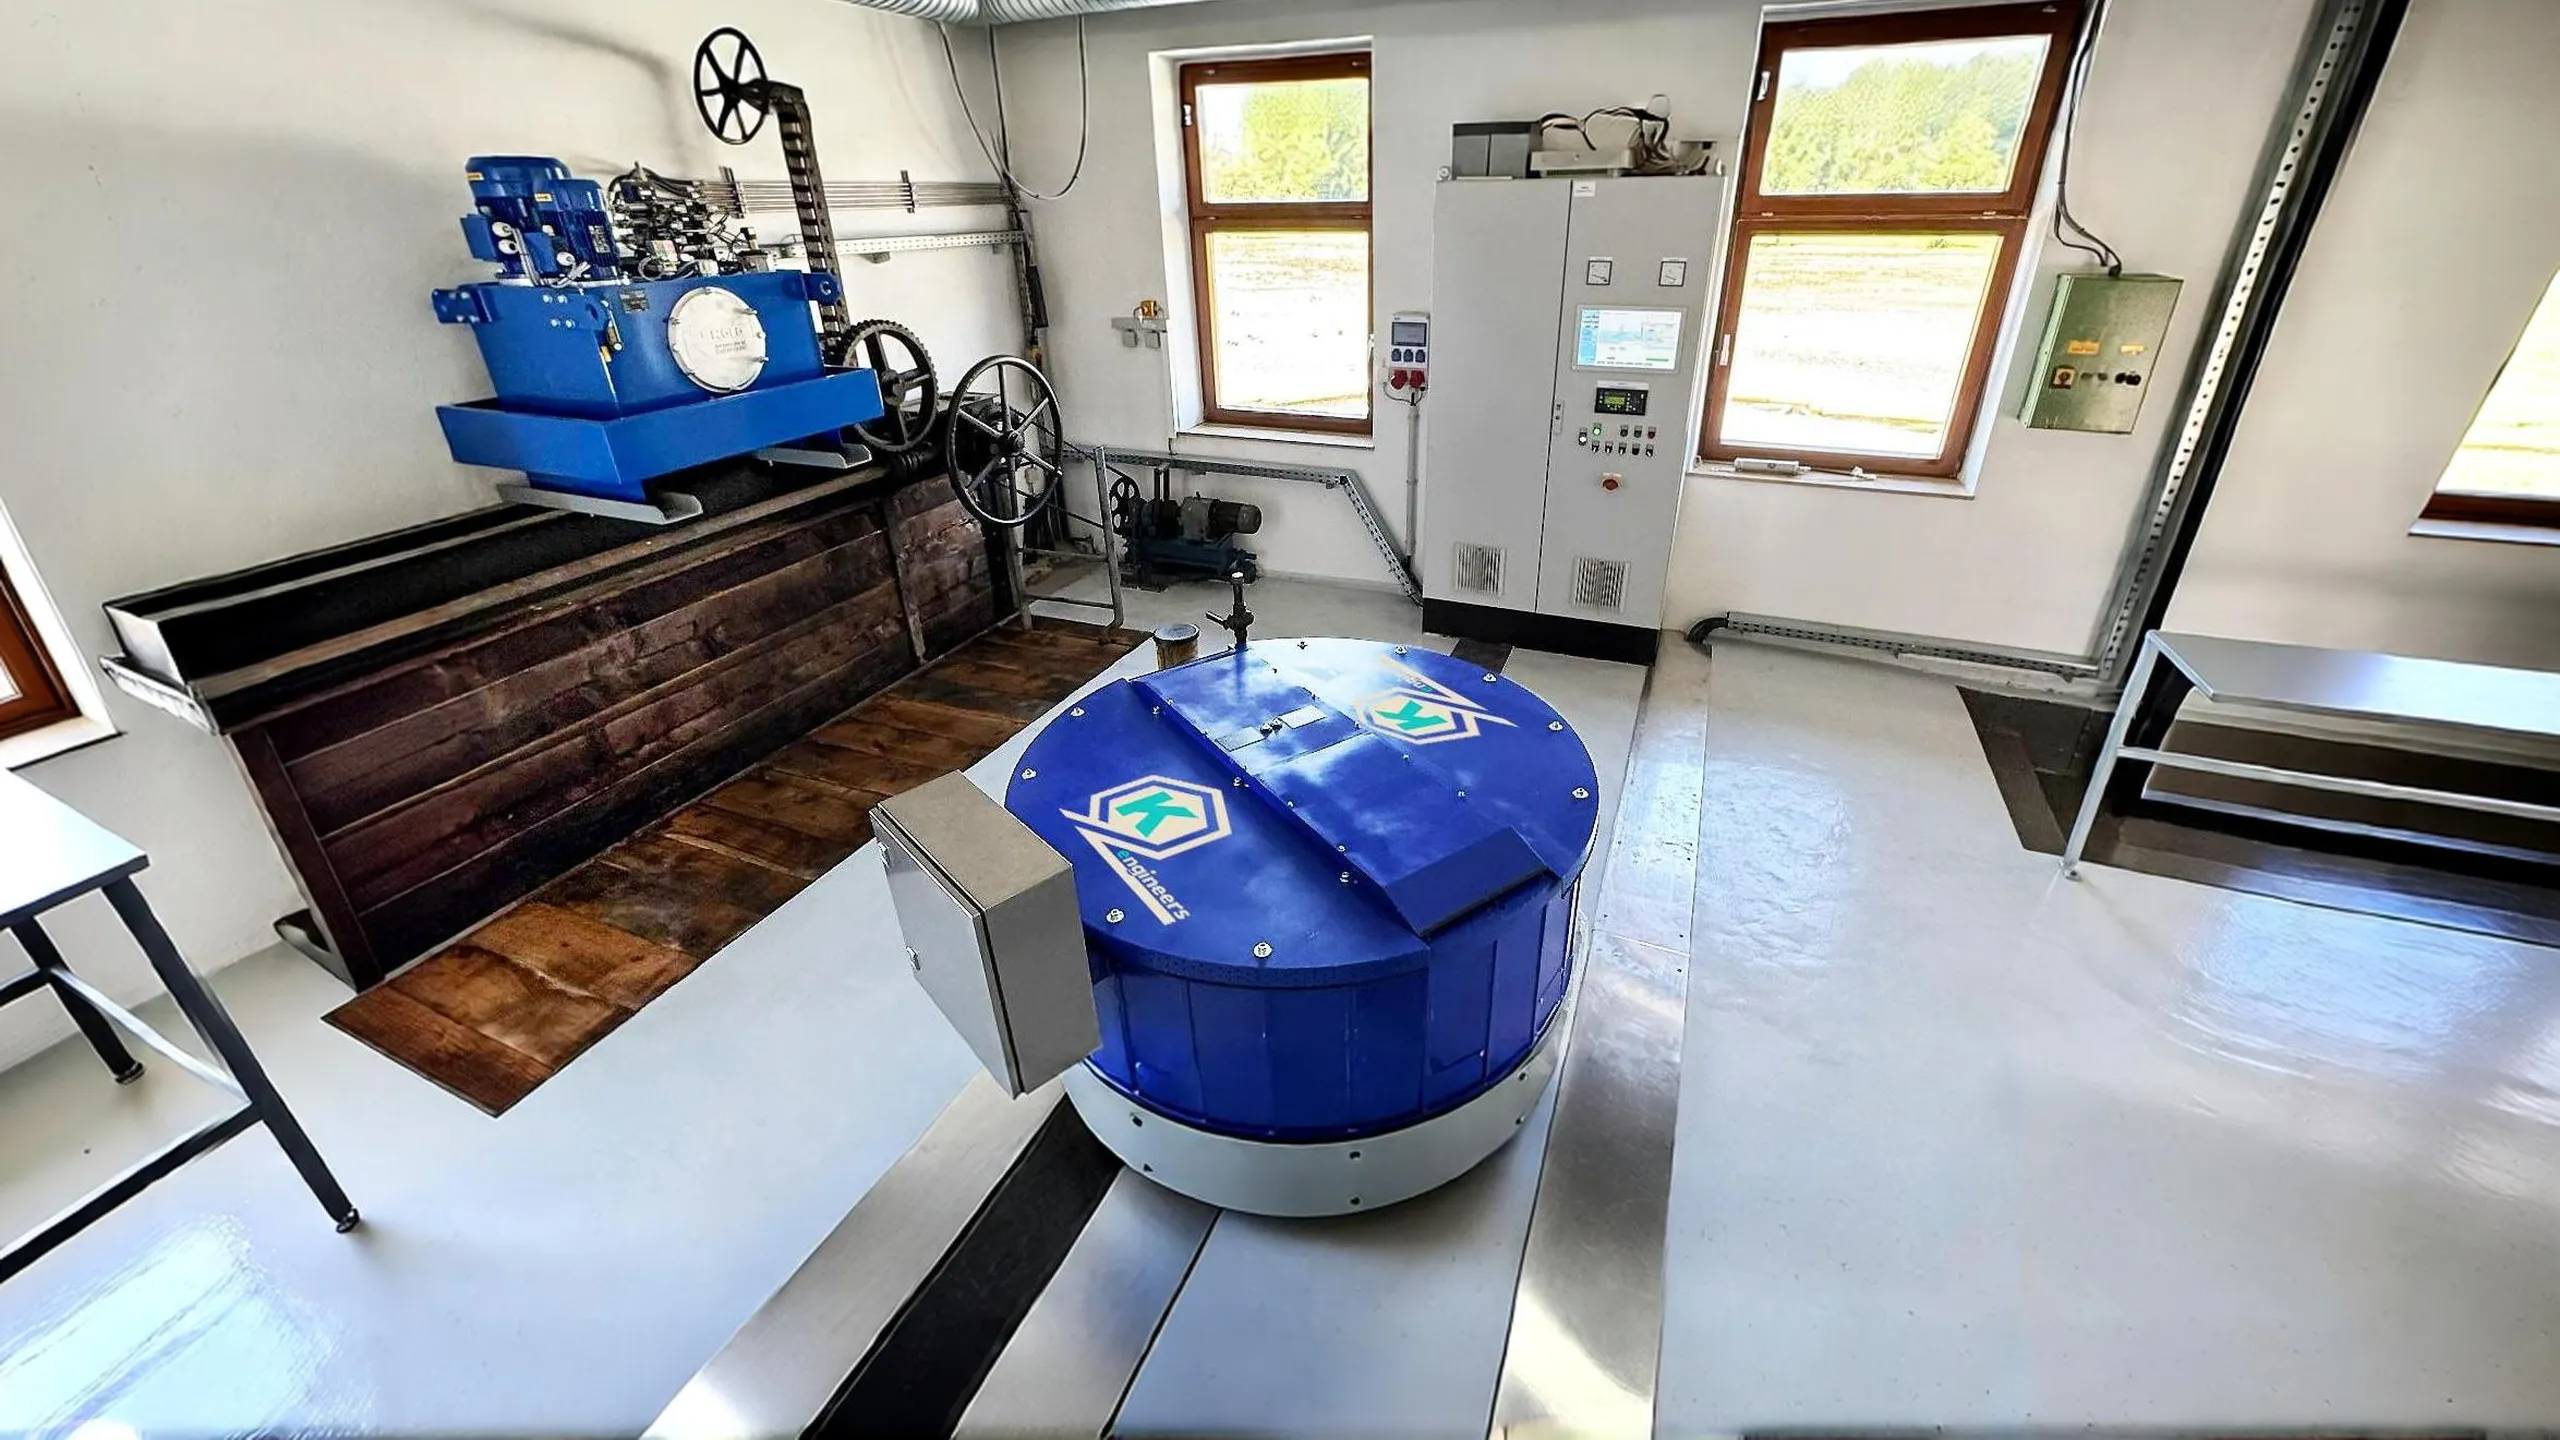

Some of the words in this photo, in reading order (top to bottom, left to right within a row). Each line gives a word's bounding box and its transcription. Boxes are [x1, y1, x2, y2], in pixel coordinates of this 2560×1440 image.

[1374, 700, 1448, 731] K
[1115, 790, 1199, 838] K
[1117, 850, 1191, 920] engineers
